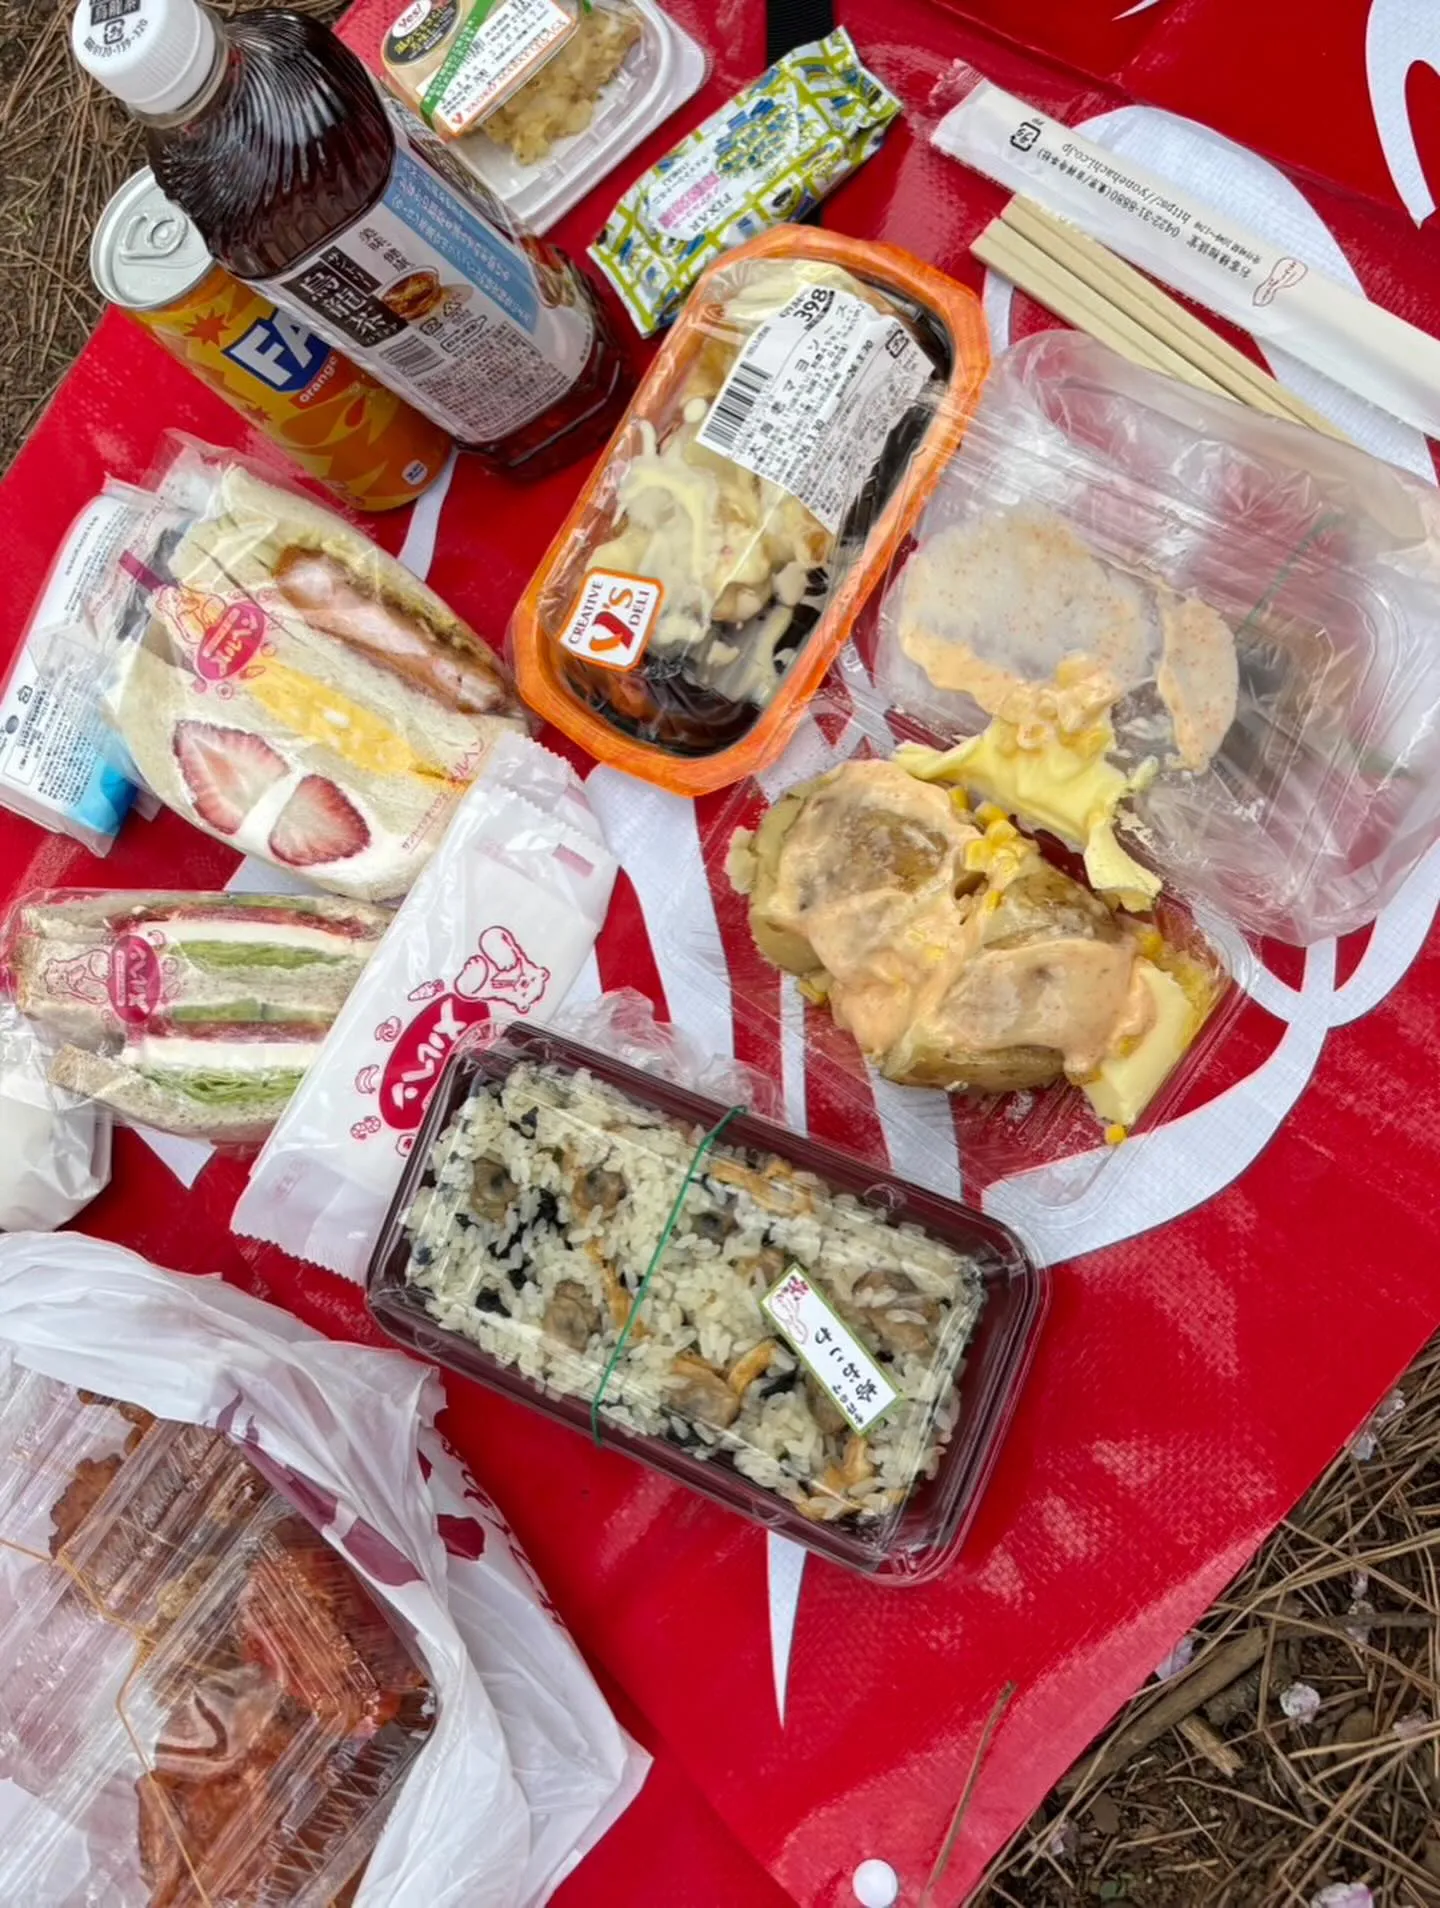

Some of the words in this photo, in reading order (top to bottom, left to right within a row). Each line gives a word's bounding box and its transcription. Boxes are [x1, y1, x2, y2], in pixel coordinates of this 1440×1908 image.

[690, 192, 733, 232] PIXAR
[326, 251, 373, 289] サントリー
[793, 287, 829, 322] 398
[299, 355, 338, 403] orange
[750, 304, 848, 458] 大海老マヨソース
[569, 580, 603, 646] CREATIVE
[629, 590, 651, 627] DELI
[126, 945, 151, 1014] メルヘン
[391, 998, 467, 1111] メルヘン
[815, 1327, 879, 1404] 蛤おこわ
